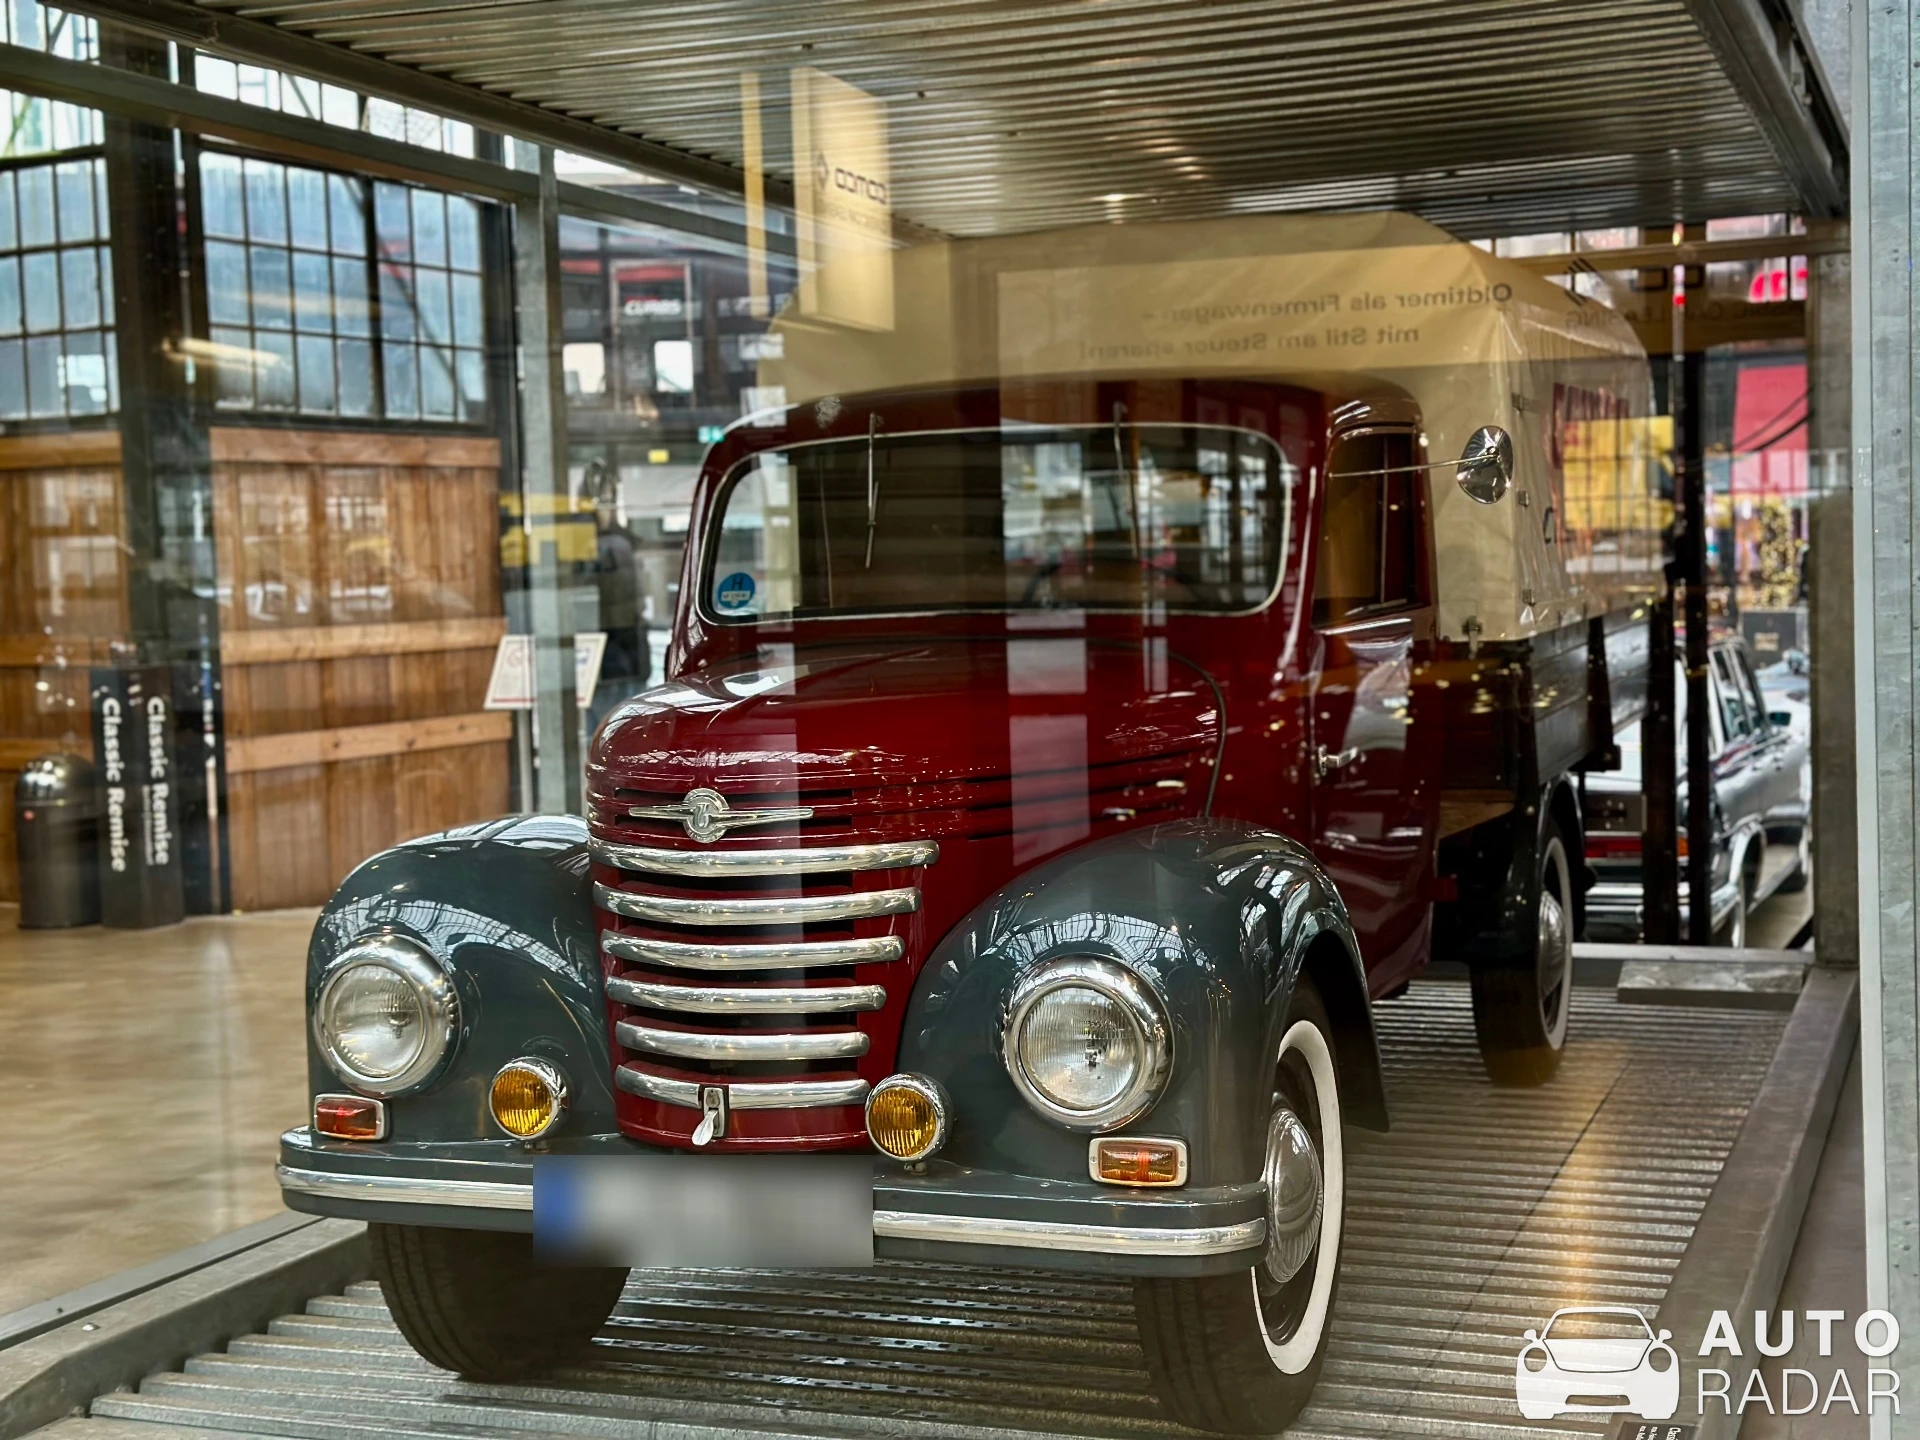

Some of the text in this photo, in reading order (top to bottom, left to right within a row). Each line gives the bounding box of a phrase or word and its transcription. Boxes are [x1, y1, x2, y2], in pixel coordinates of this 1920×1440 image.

[731, 575, 744, 590] H
[147, 696, 169, 779] Classic
[102, 697, 130, 873] Classic Remise
[152, 782, 173, 865] Remise
